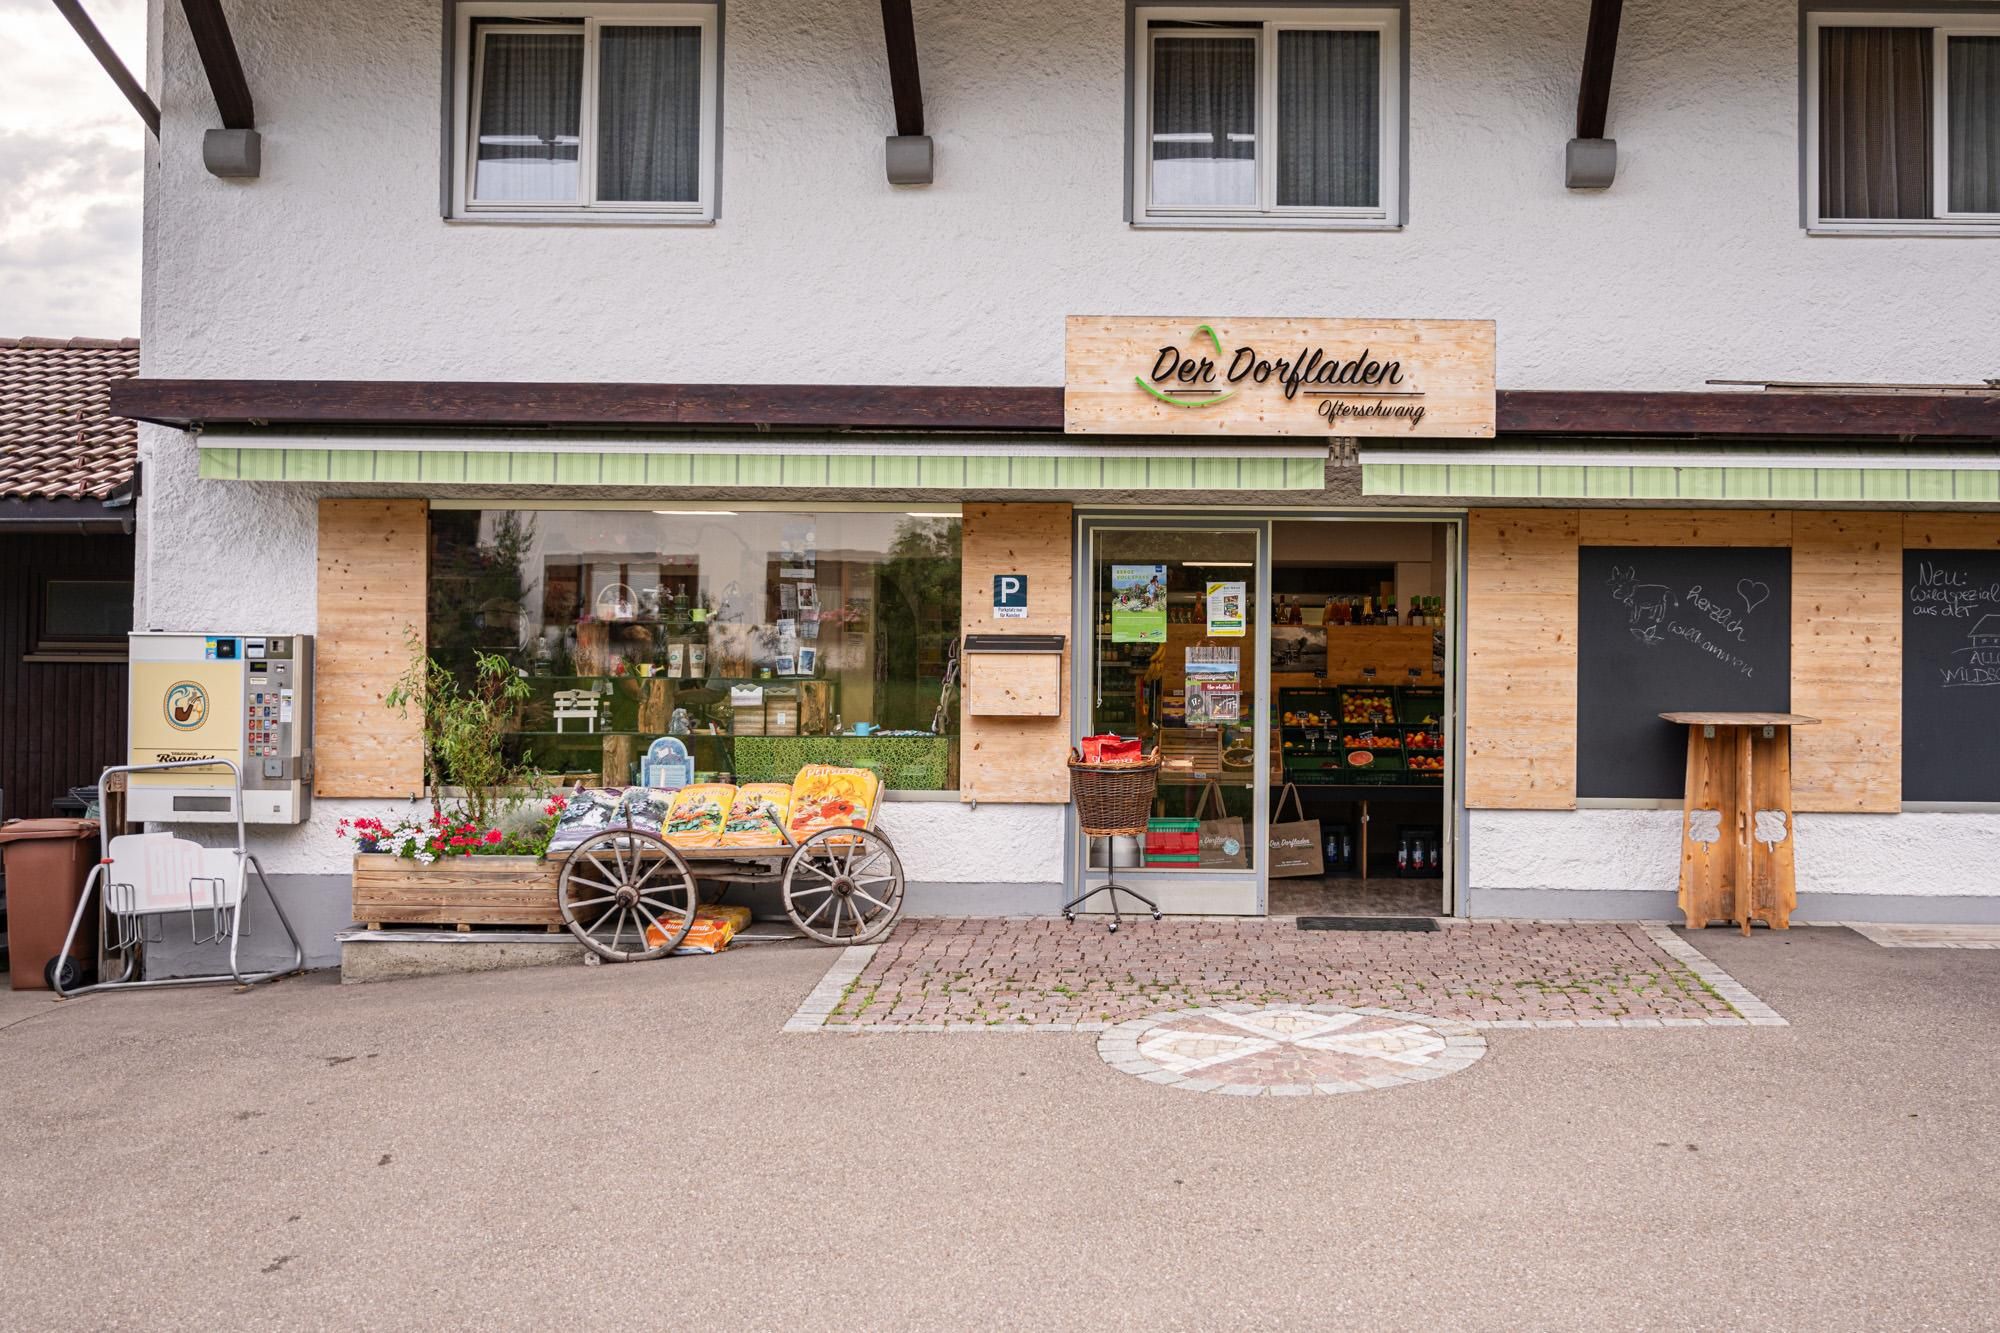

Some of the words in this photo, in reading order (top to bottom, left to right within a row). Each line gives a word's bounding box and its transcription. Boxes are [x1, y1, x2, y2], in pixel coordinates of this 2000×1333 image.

[1150, 345, 1217, 384] Der
[1226, 346, 1404, 401] Dorfladen
[1317, 398, 1427, 425] Ofterschwang
[1919, 560, 1968, 587] Neu:
[1001, 577, 1020, 604] P
